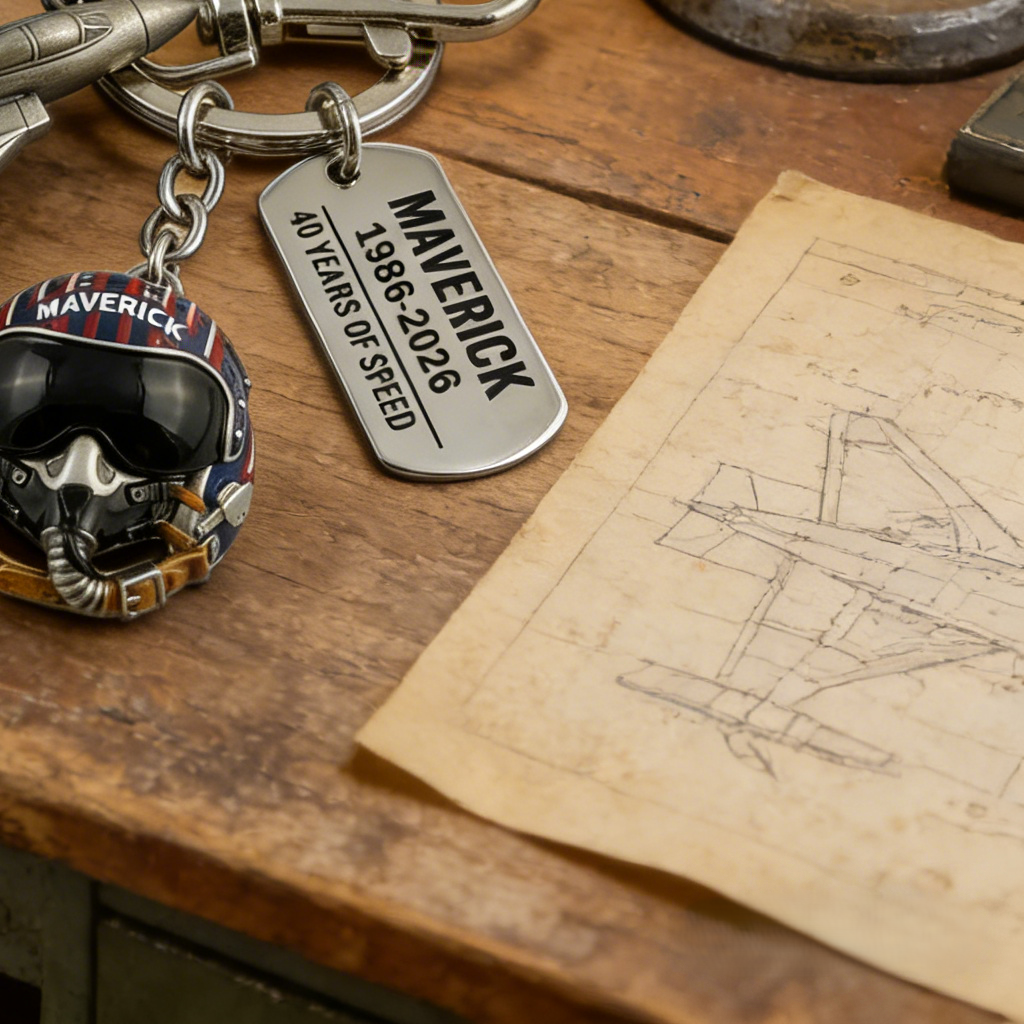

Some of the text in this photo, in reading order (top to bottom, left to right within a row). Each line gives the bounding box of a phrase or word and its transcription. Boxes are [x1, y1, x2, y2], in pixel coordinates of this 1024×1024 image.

[36, 292, 187, 341] MAVERICK
[290, 211, 416, 431] 40 YEARS OF SPEED
[355, 222, 462, 394] 1986-2026
[387, 189, 535, 402] MAVERICK
